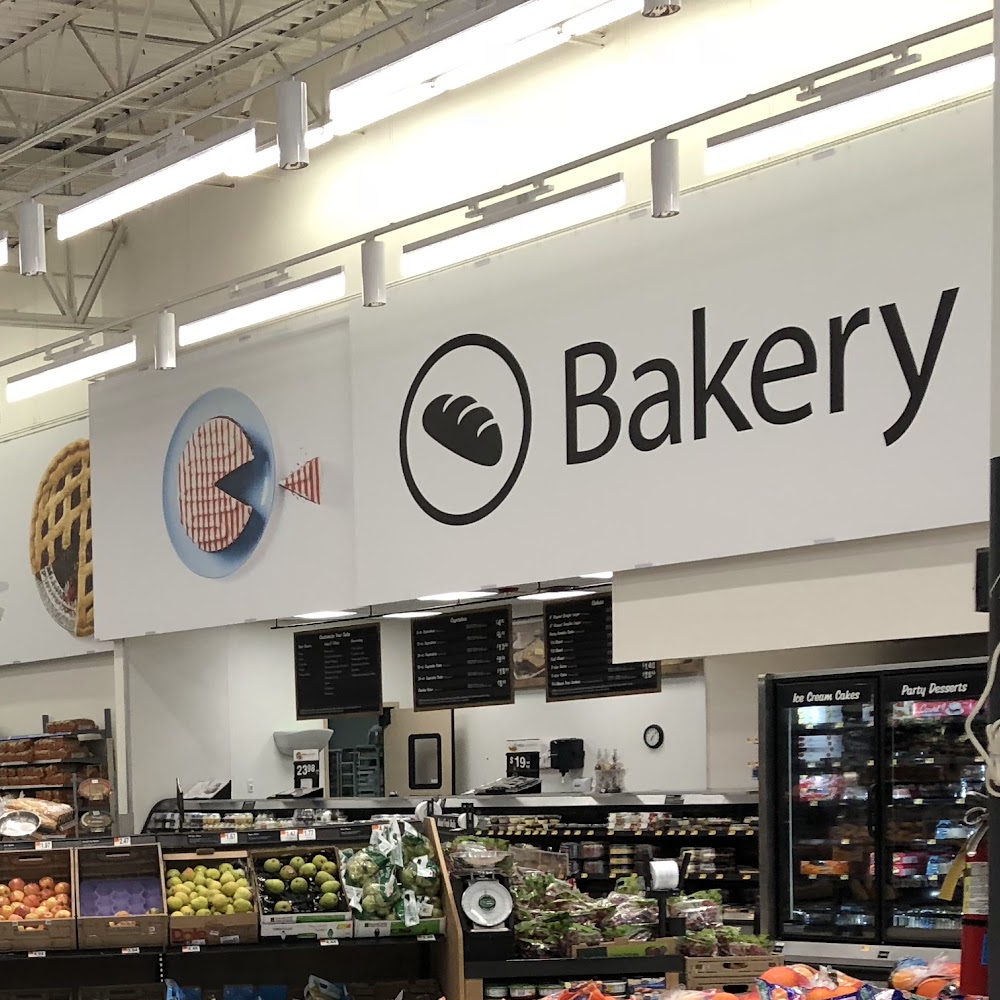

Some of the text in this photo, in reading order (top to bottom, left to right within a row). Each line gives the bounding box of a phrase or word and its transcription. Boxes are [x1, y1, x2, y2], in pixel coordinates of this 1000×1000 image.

[565, 286, 960, 465] Bakery
[793, 690, 860, 703] Ice Cream Cakes
[901, 683, 968, 697] Party Desserts
